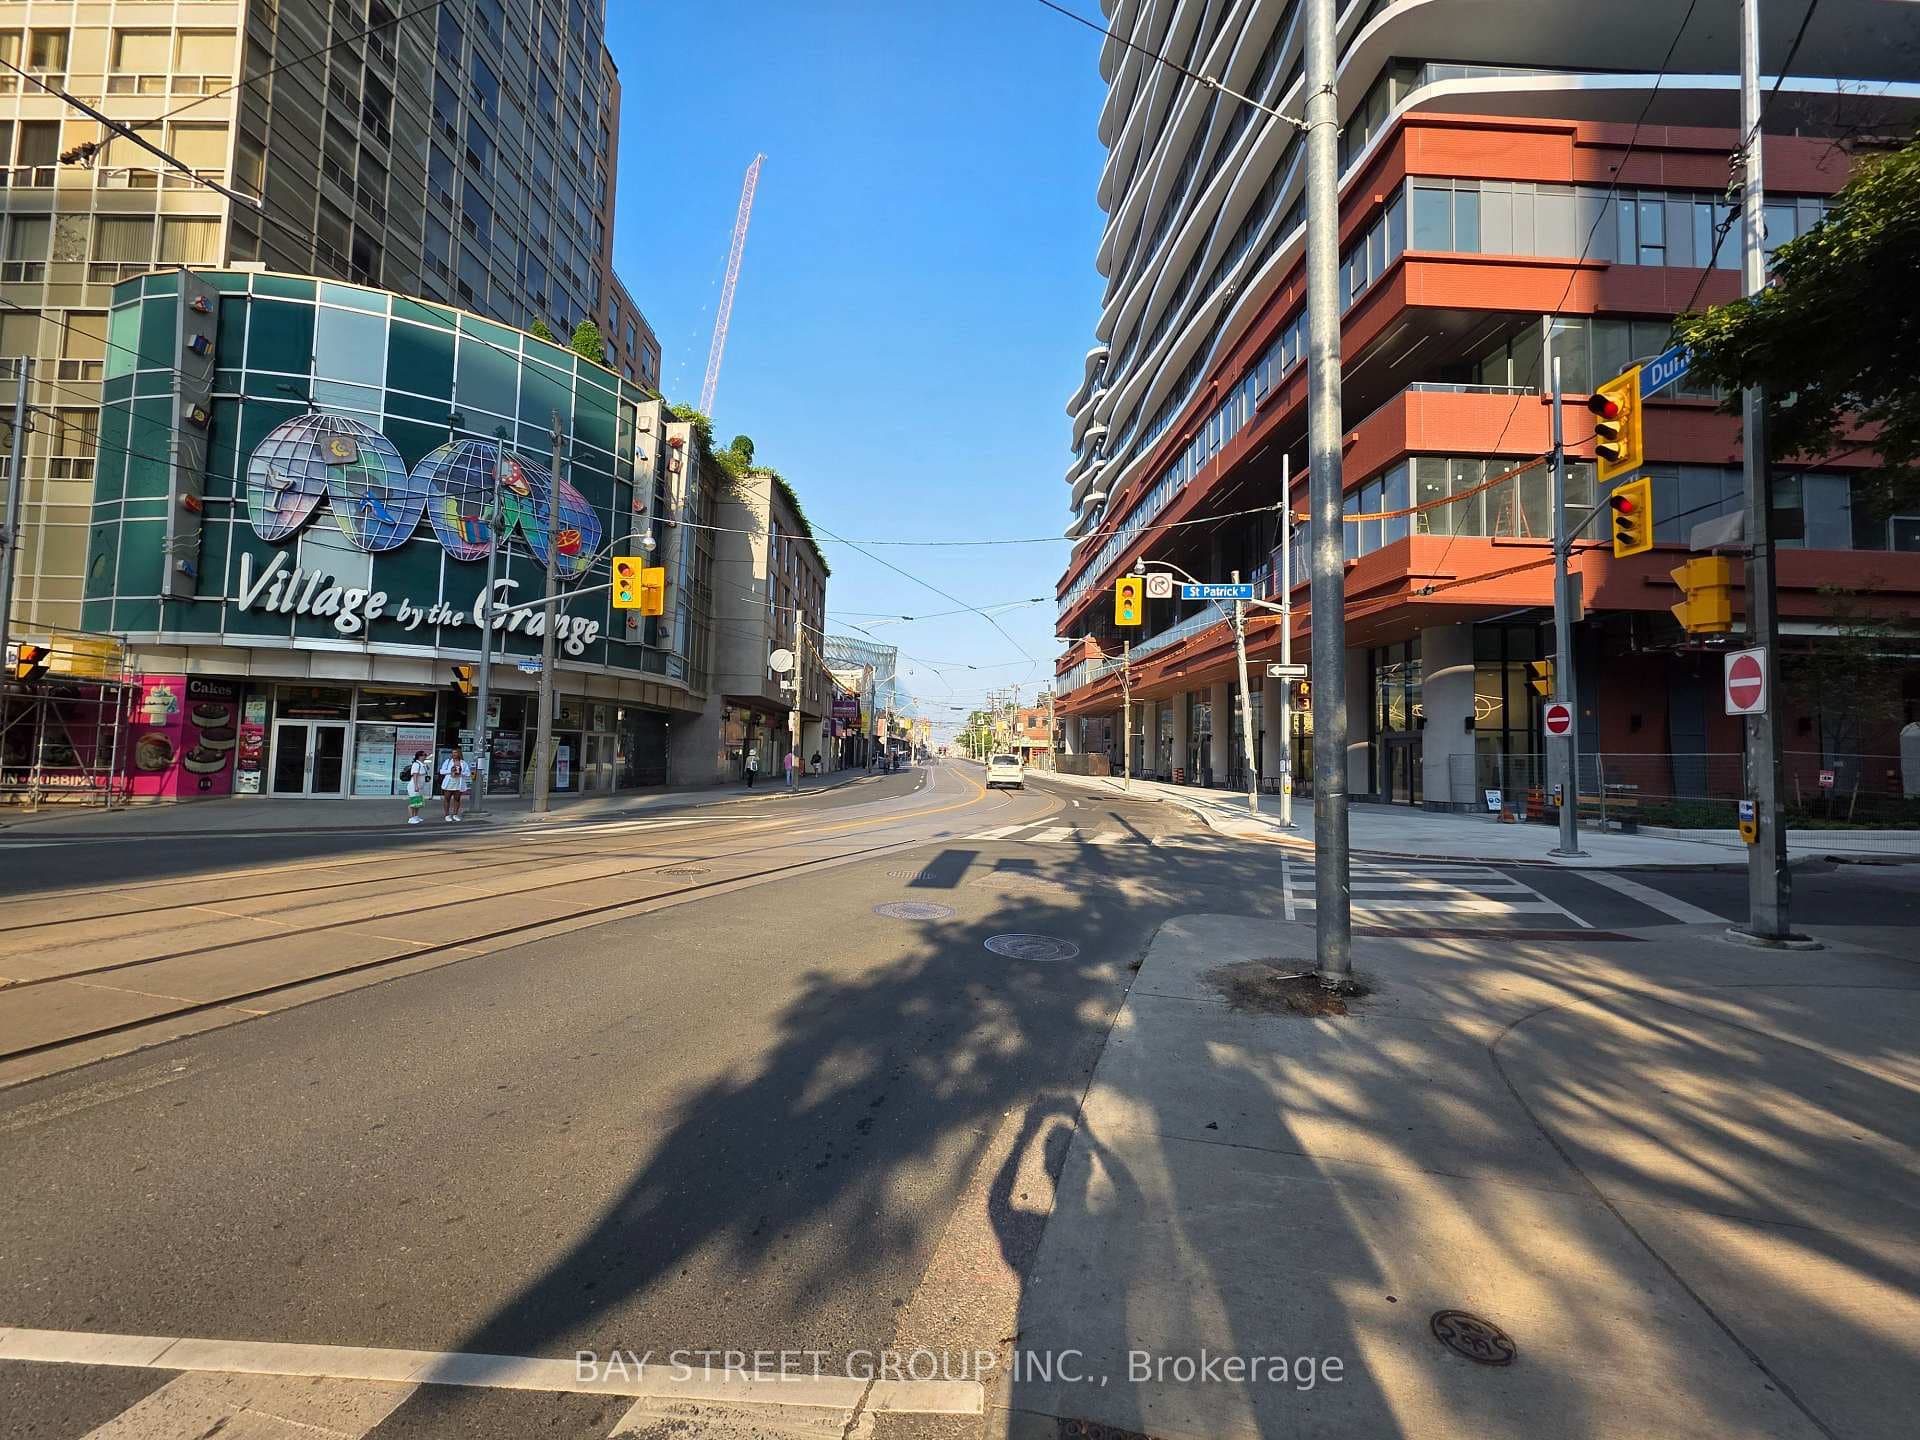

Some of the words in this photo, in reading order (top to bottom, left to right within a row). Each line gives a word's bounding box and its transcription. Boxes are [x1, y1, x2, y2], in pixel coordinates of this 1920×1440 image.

[1189, 587, 1200, 597] St
[1203, 587, 1239, 597] Patrick
[239, 551, 387, 633] Village
[396, 598, 423, 631] by
[428, 602, 464, 627] the
[473, 578, 600, 656] Grange
[190, 680, 232, 696] Cakes
